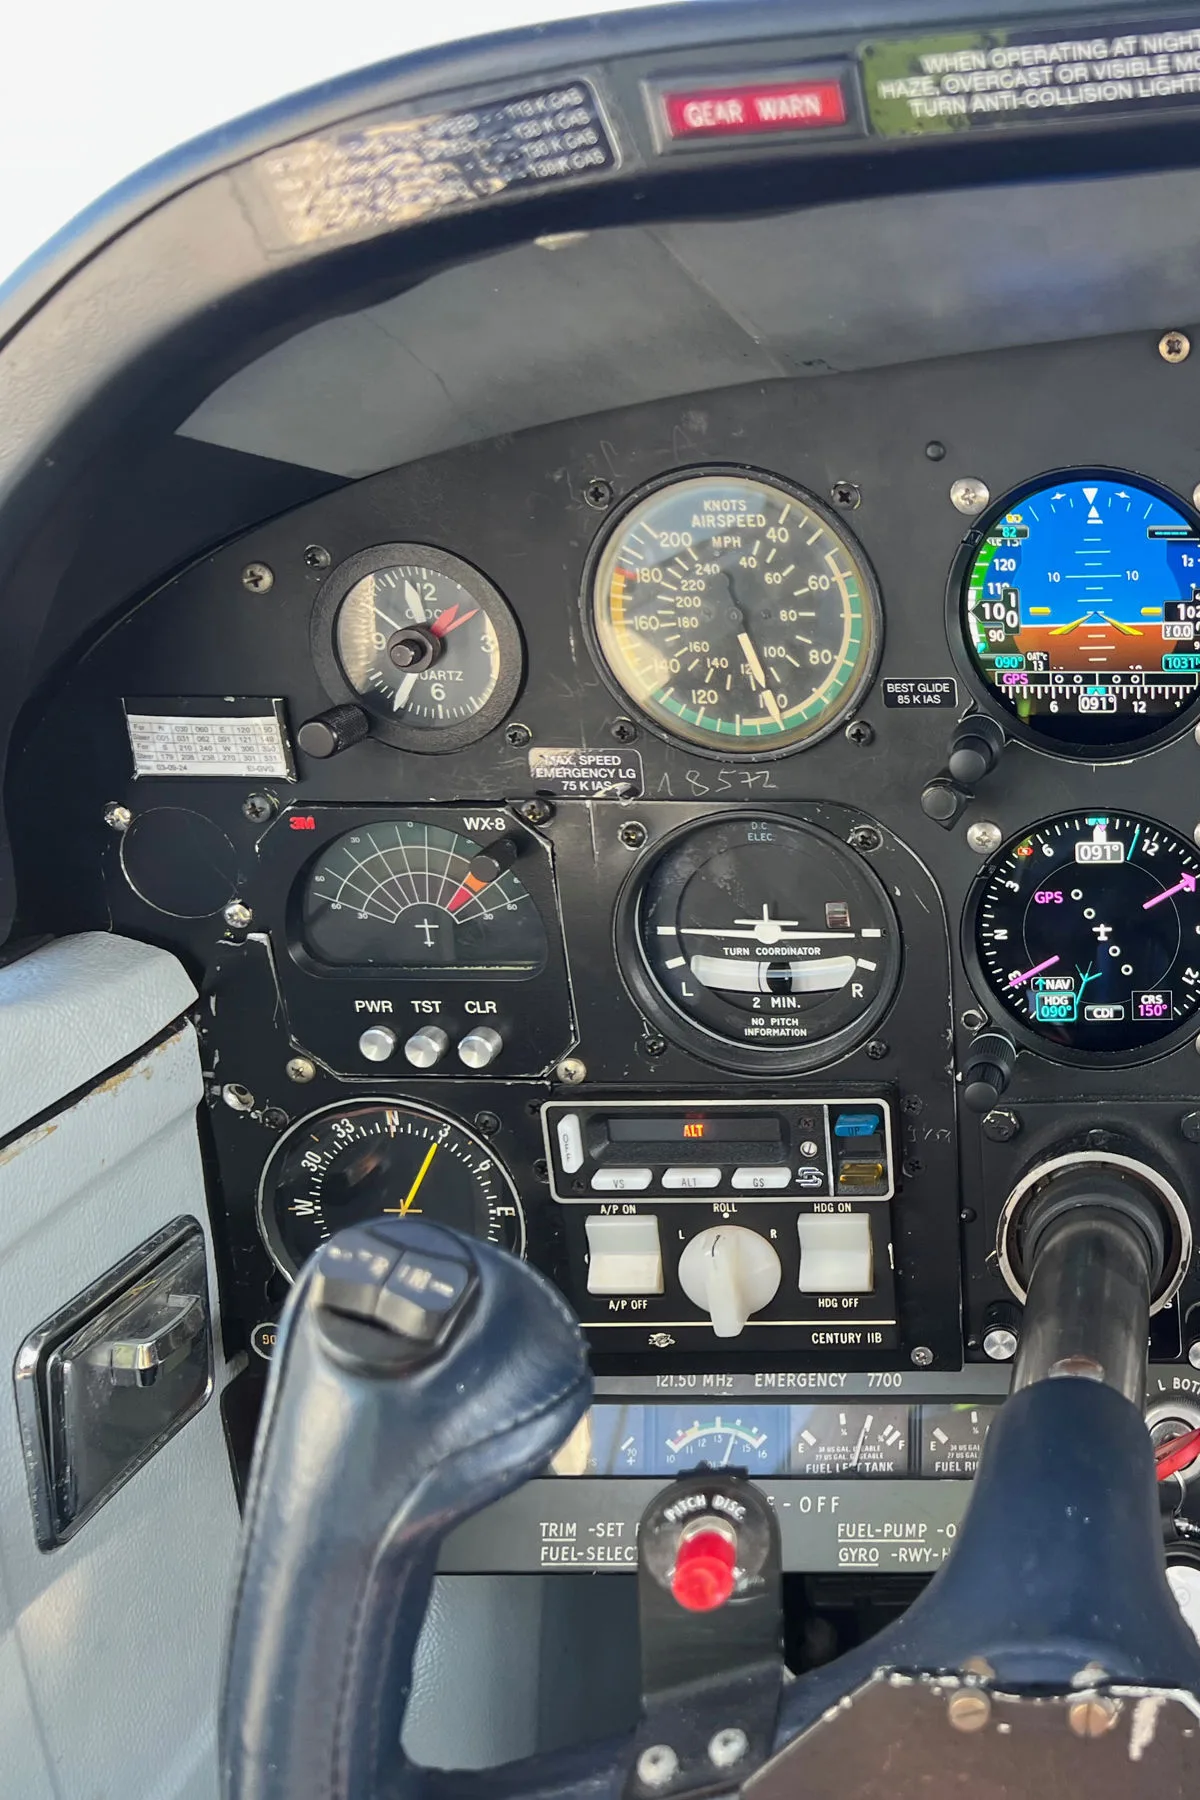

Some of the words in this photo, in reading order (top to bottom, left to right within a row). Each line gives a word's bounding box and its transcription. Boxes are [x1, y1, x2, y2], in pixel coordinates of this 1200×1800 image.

[922, 53, 985, 74] WHEN
[992, 42, 1108, 68] OPERATING
[1113, 36, 1138, 57] AT
[943, 67, 1053, 94] OVERCAST
[1056, 64, 1089, 84] OR
[1095, 55, 1169, 79] VISIBLE
[908, 96, 965, 117] TURN
[972, 84, 1134, 112] ANTI-COLLISION
[684, 100, 744, 127] GEAR
[754, 94, 821, 120] WARN
[704, 500, 747, 511] KNOTS
[691, 514, 766, 528] AIRSPEED
[659, 532, 692, 548] 200
[766, 528, 789, 542] 40
[712, 537, 741, 548] MPH
[993, 559, 1016, 571] 120
[1047, 572, 1060, 582] 10
[1126, 571, 1139, 581] 10
[1003, 674, 1028, 684] GPS
[887, 684, 914, 692] BEST
[916, 683, 950, 692] GLIDE
[691, 690, 718, 704] 120
[898, 696, 910, 704] 85
[912, 695, 921, 704] K
[922, 695, 941, 703] IAS
[1081, 697, 1114, 710] 091°
[579, 756, 621, 765] SPEED
[537, 768, 614, 778] EMERGENCY
[619, 769, 636, 778] LG
[562, 781, 576, 790] 75
[580, 781, 589, 790] K
[591, 781, 612, 790] IAS
[289, 817, 315, 829] 3M
[463, 818, 505, 830] WX-8
[1080, 845, 1119, 860] 091°
[1034, 891, 1063, 903] GPS
[723, 947, 749, 955] TURN
[756, 947, 820, 955] COORDINATOR
[1045, 979, 1070, 989] NAV
[752, 998, 760, 1008] 2
[771, 998, 801, 1008] MIN.
[1044, 997, 1068, 1005] HDG
[1141, 995, 1163, 1004] CRS
[355, 1001, 393, 1013] PWR
[411, 1001, 442, 1013] TST
[465, 1001, 497, 1014] CLR
[1042, 1006, 1071, 1017] 090°
[1139, 1005, 1167, 1016] 150°
[1093, 1008, 1114, 1018] CDI
[751, 1018, 764, 1026] NO
[770, 1018, 799, 1026] PITCH
[744, 1028, 807, 1036] INFORMATION
[684, 1124, 703, 1138] ALT
[601, 1204, 620, 1214] A/P
[621, 1204, 636, 1214] ON
[713, 1203, 737, 1213] ROLL
[813, 1203, 832, 1212] HDG
[835, 1203, 852, 1212] ON
[609, 1300, 628, 1310] A/P
[630, 1300, 647, 1309] OFF
[818, 1298, 837, 1308] HDG
[840, 1298, 859, 1307] OFF
[811, 1333, 862, 1344] CENTURY
[656, 1375, 696, 1387] 121.50
[703, 1375, 733, 1387] MHz
[755, 1374, 847, 1387] EMERGENCY
[867, 1374, 902, 1388] 7700
[664, 1495, 706, 1523] PITCH
[540, 1523, 576, 1537] TRIM
[588, 1523, 624, 1537] -SET
[837, 1524, 927, 1539] FUEL-PUMP
[839, 1547, 879, 1561] GYRO
